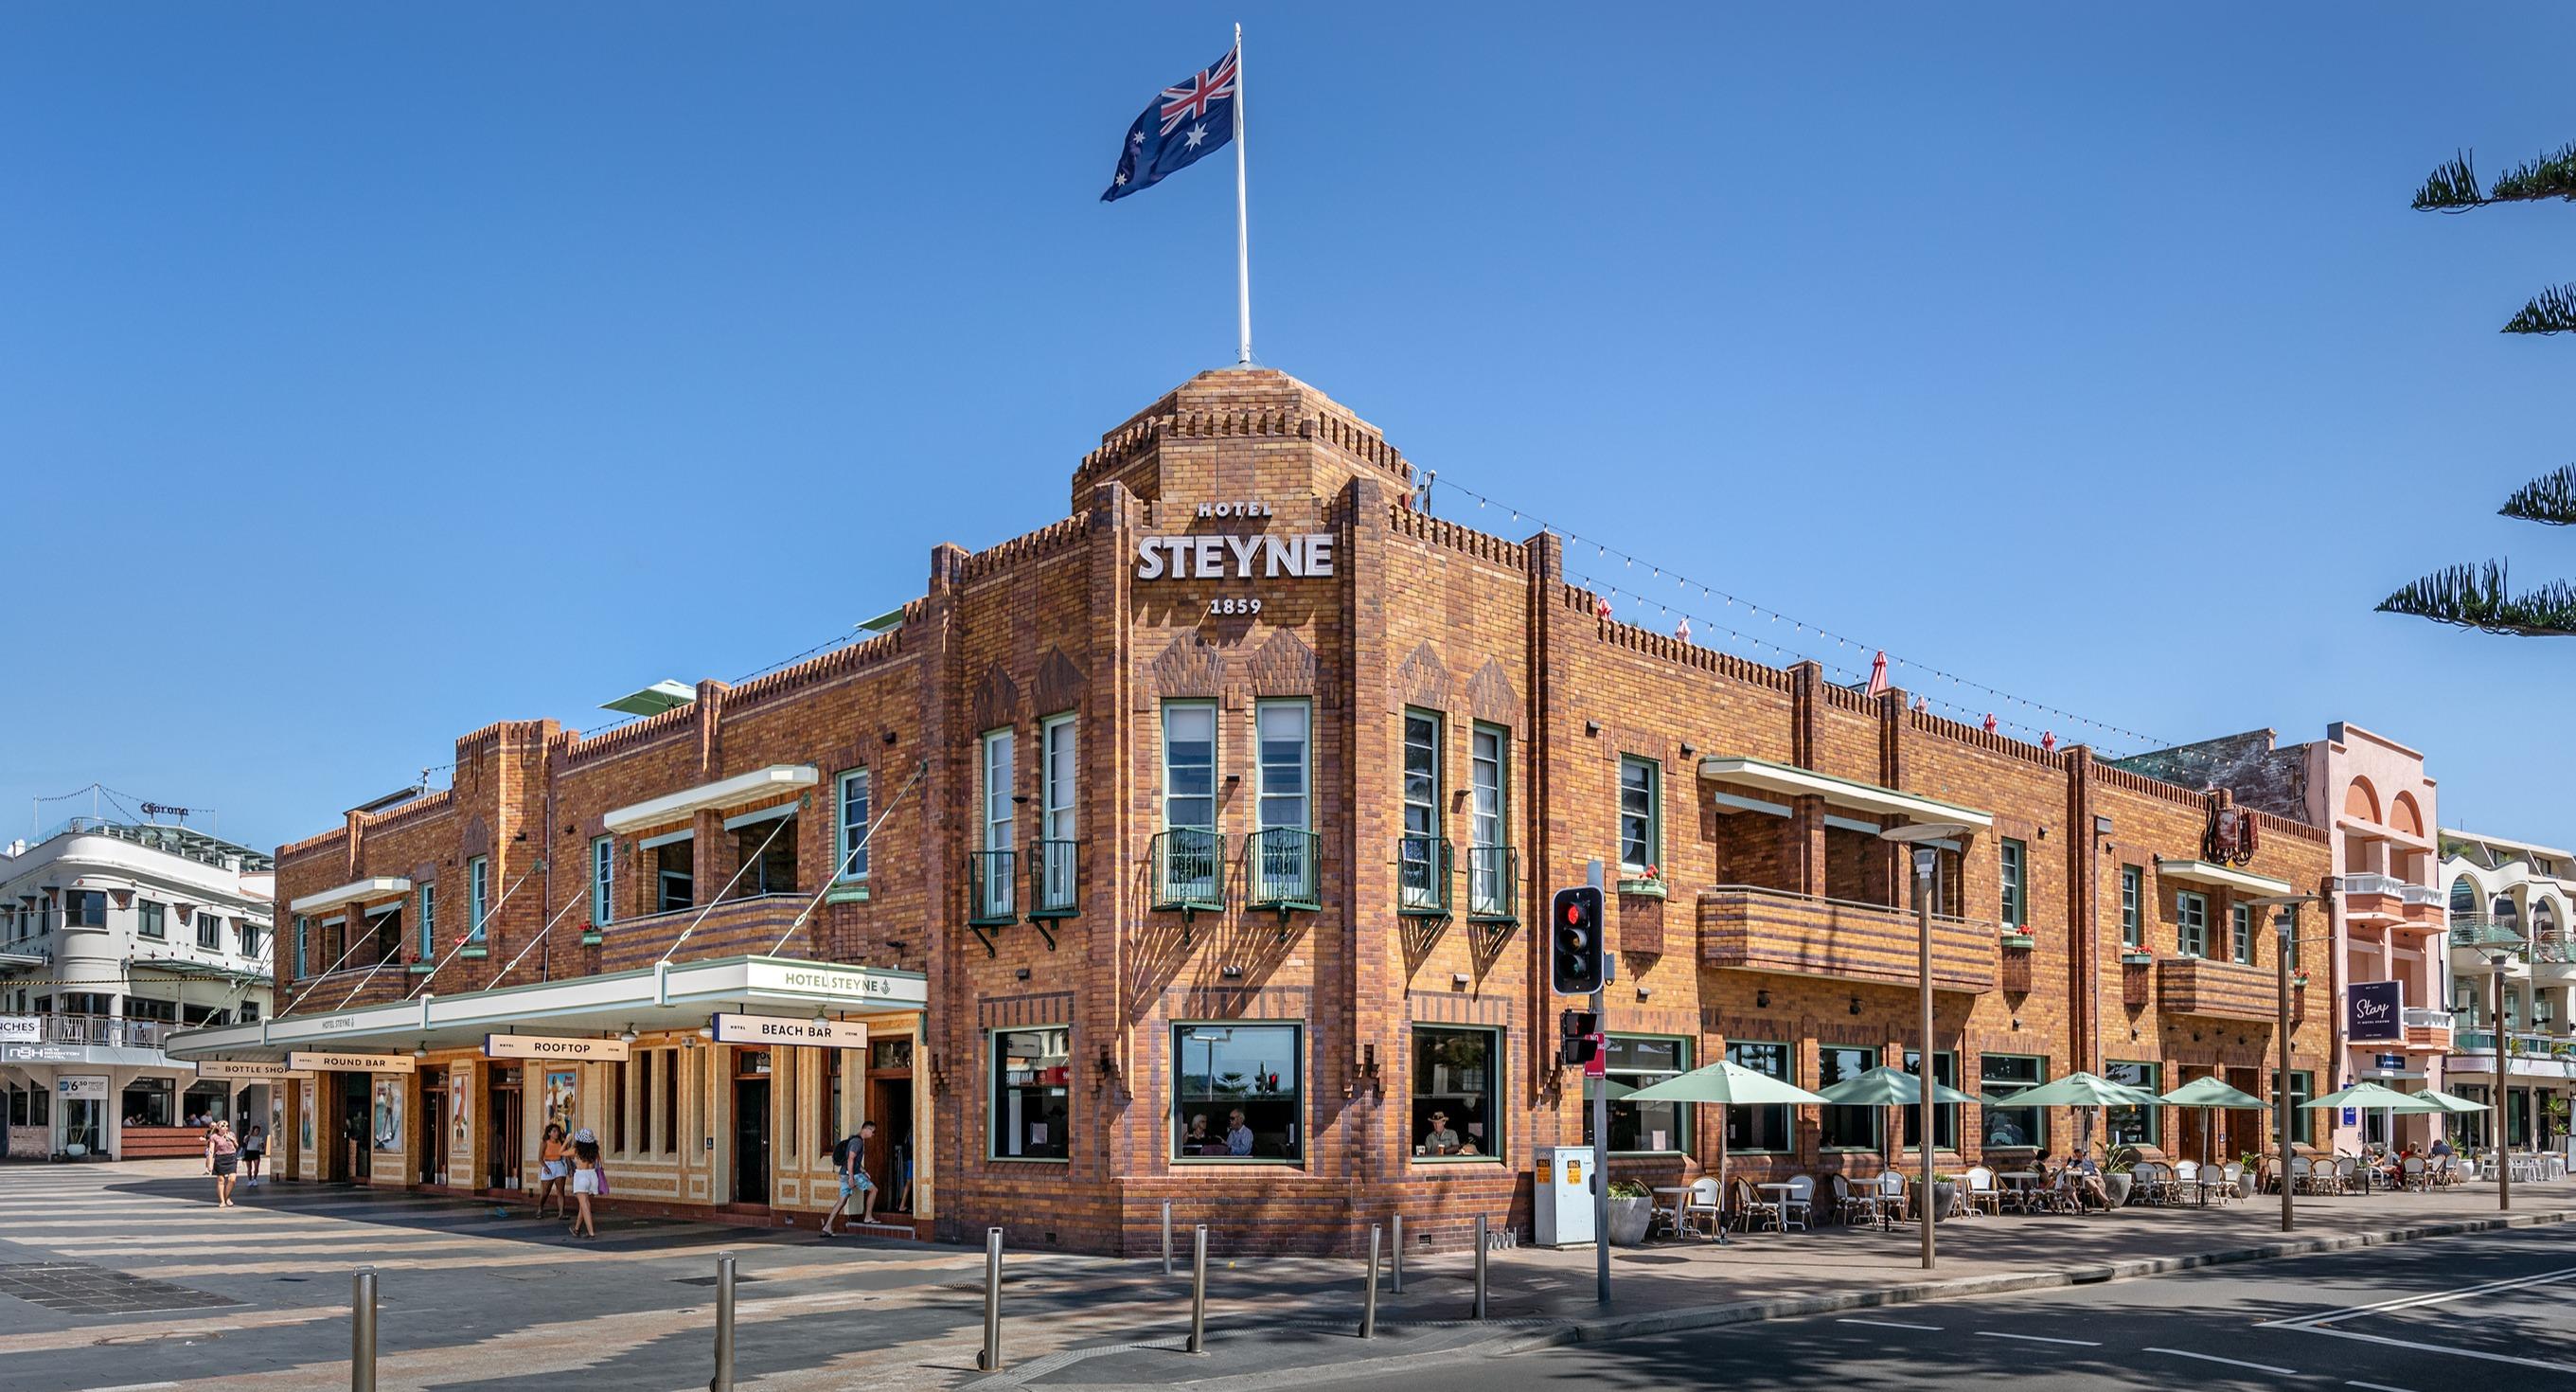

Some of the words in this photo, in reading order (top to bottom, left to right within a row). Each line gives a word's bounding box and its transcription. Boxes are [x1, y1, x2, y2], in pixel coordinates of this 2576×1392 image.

[1198, 501, 1272, 518] HOTEL
[1138, 534, 1334, 580] STEYNE
[1210, 598, 1262, 615] 1859
[140, 802, 189, 816] Corona
[785, 973, 828, 988] HOTEL
[831, 976, 879, 991] STEYNE
[2356, 998, 2389, 1019] Stay
[761, 1024, 804, 1037] BEACH
[808, 1026, 832, 1039] BAR
[534, 1043, 591, 1054] ROOFTOP
[324, 1058, 362, 1066] ROUND
